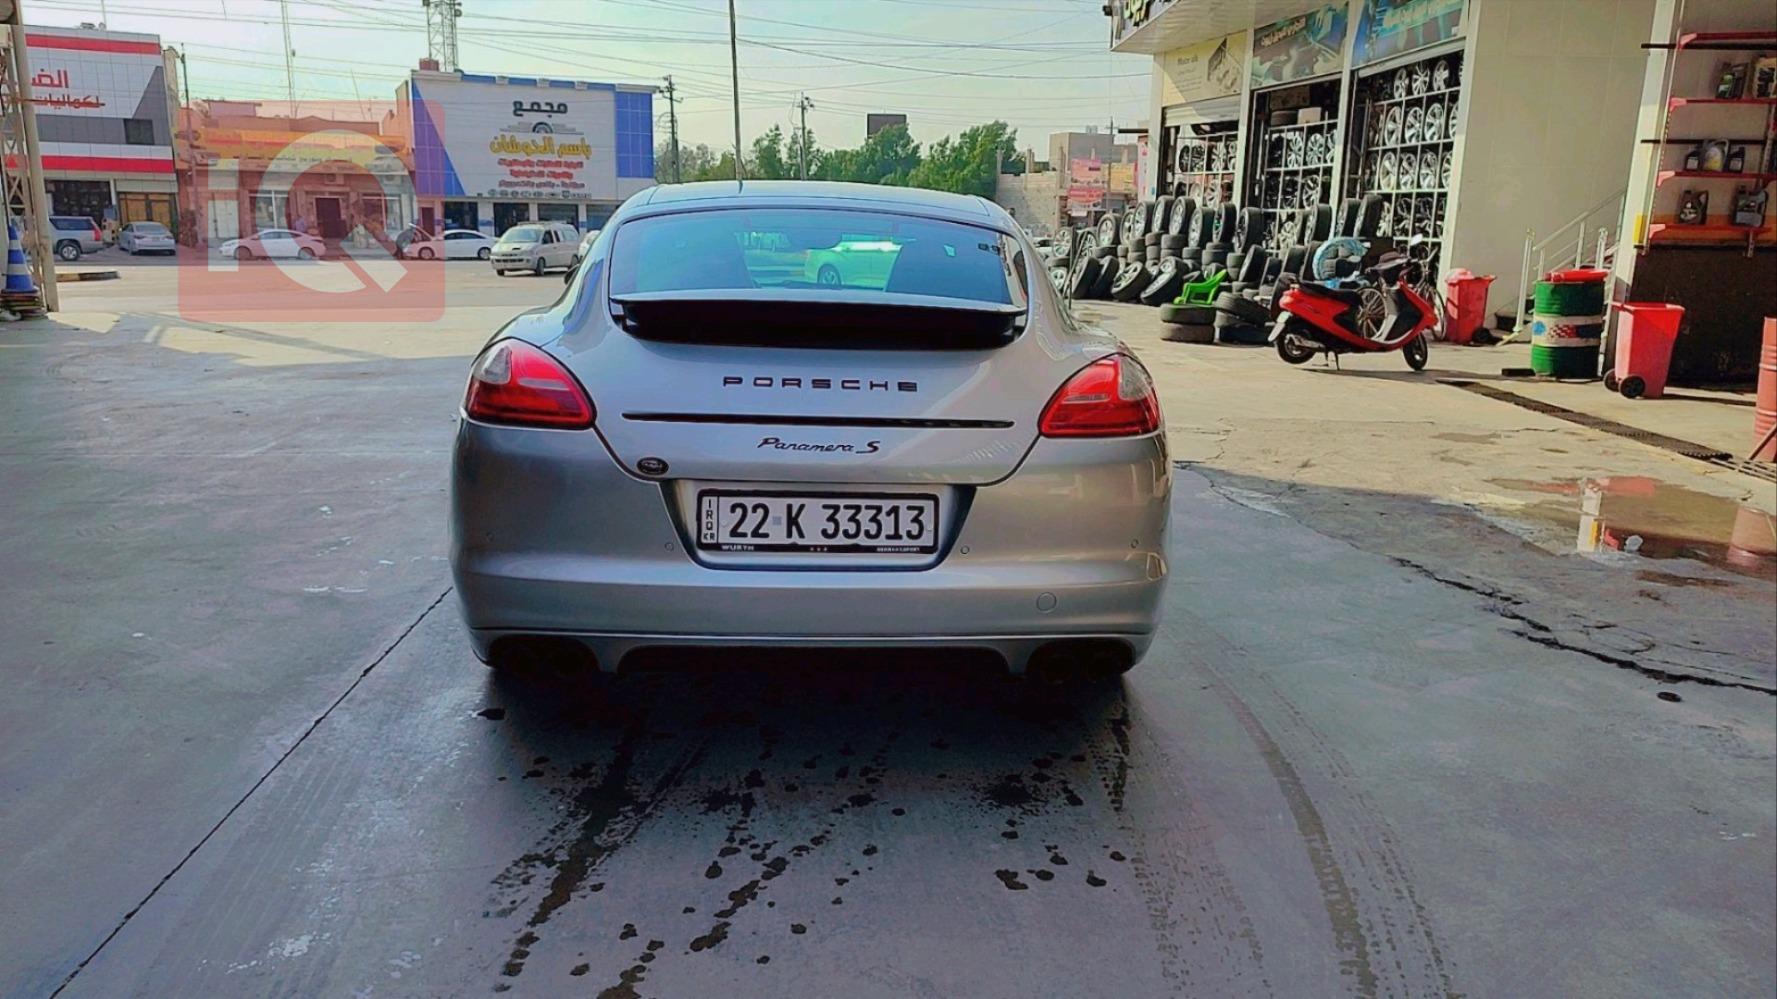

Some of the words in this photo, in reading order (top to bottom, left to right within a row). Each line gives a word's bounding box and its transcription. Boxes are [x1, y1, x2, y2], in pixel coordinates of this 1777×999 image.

[513, 101, 568, 118] مجمع
[557, 137, 592, 160] باسم
[723, 376, 917, 392] PORSCHE
[757, 437, 854, 452] Panamera
[856, 441, 880, 454] S
[729, 502, 770, 538] 22
[786, 503, 806, 539] K
[820, 504, 925, 540] 33313
